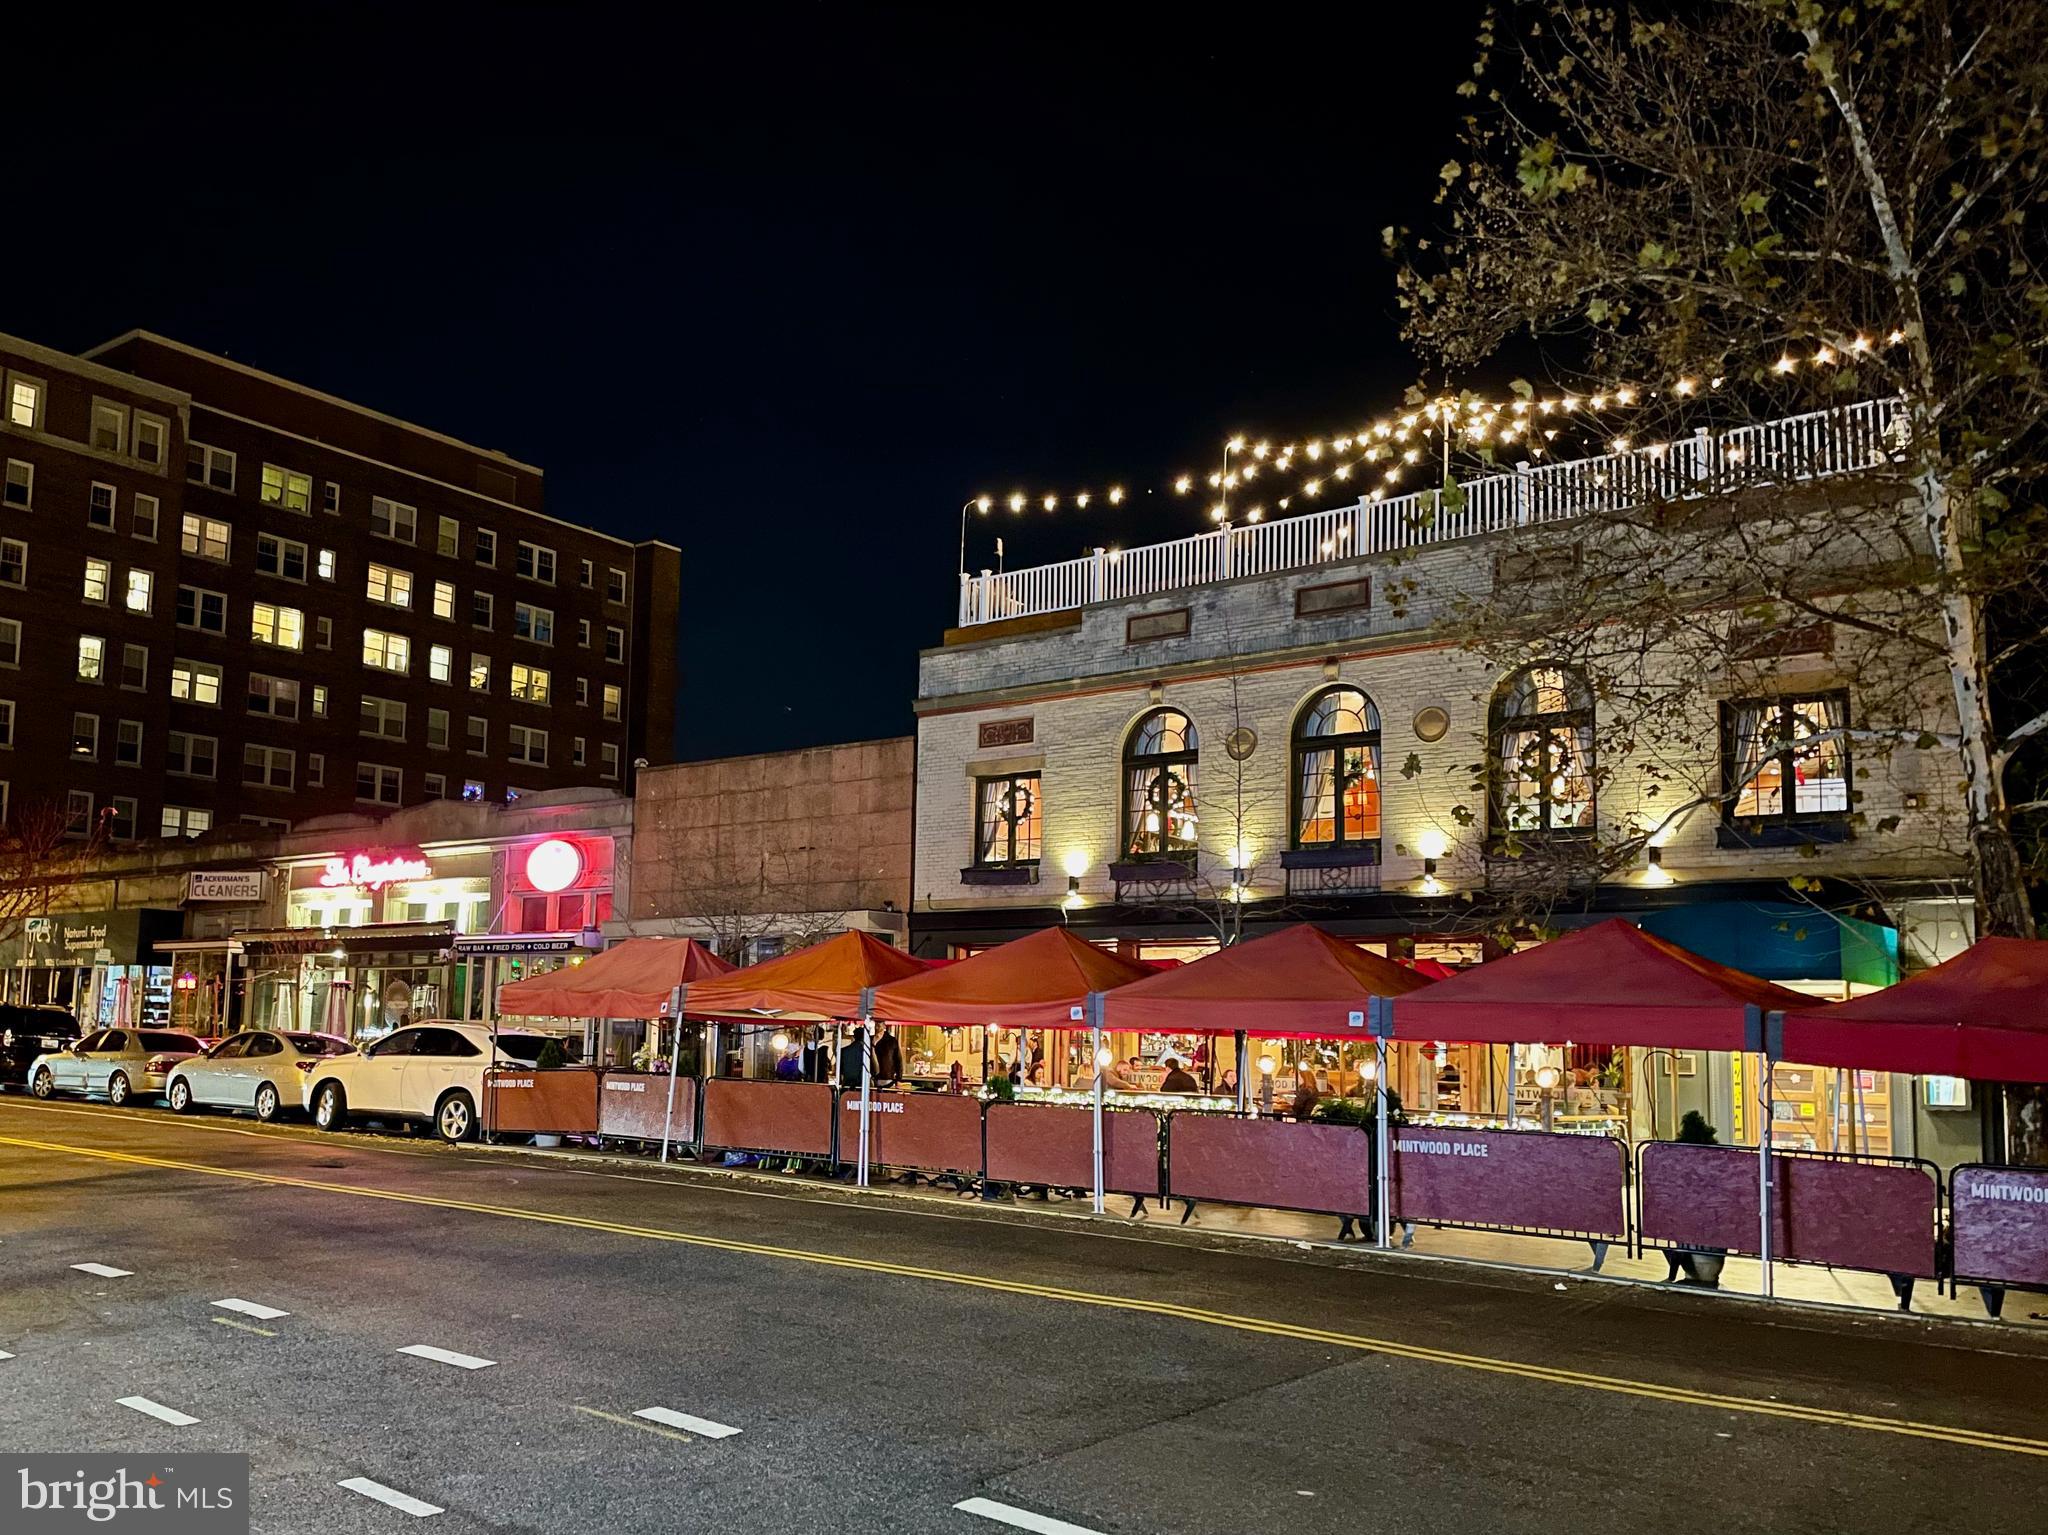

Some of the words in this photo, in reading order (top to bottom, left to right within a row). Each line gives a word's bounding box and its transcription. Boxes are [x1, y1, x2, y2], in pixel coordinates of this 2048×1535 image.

[194, 885, 258, 897] CLEANERS
[64, 925, 88, 938] Natural
[90, 924, 107, 937] Food
[64, 937, 105, 953] Supermarket
[517, 1079, 534, 1088] PLACE
[846, 1101, 882, 1112] MINTOOD
[883, 1102, 904, 1113] PLACE
[1393, 1139, 1451, 1155] MINTWOOD
[1453, 1143, 1488, 1157] PLACE
